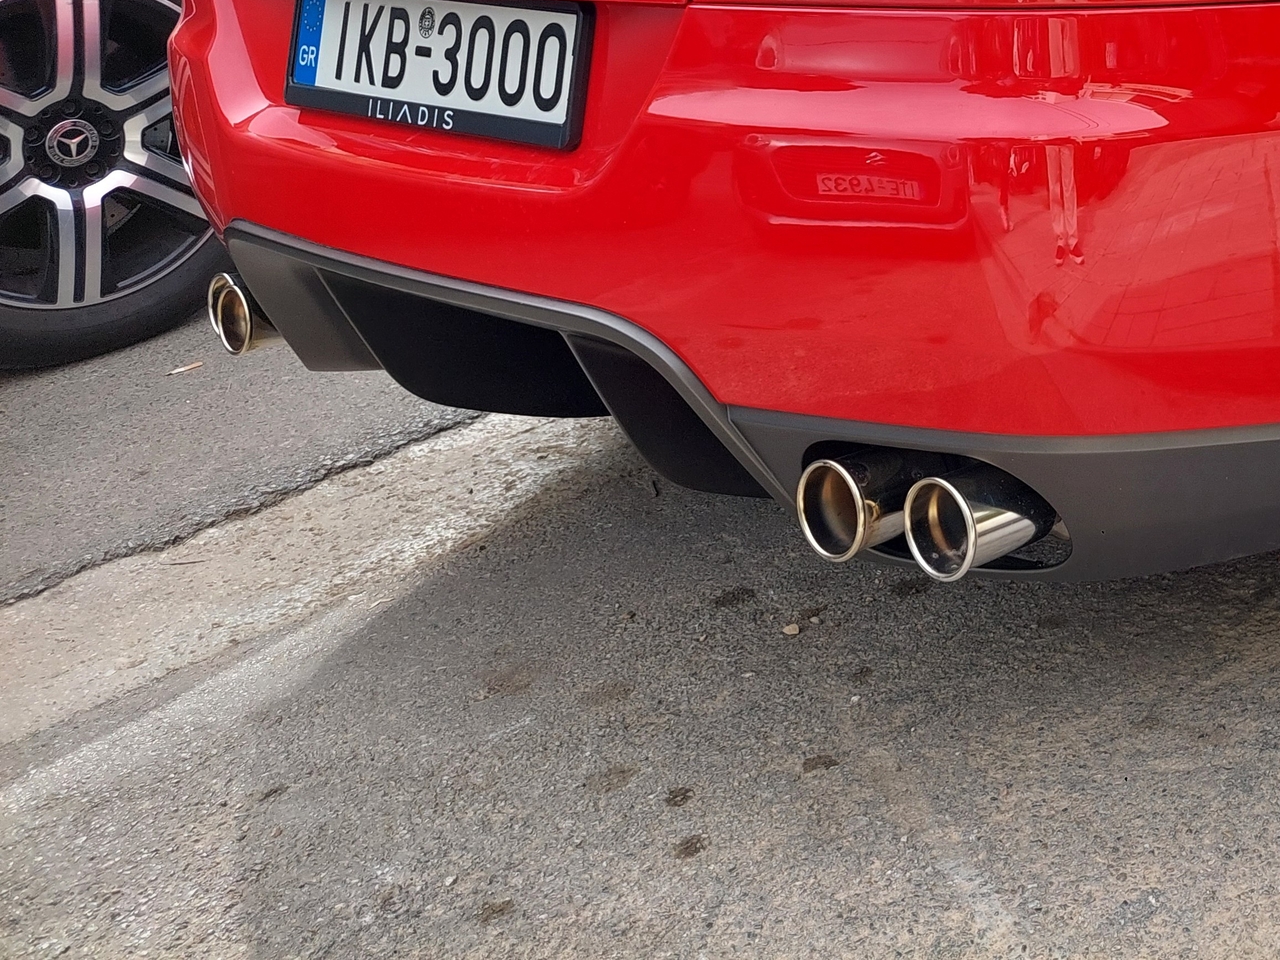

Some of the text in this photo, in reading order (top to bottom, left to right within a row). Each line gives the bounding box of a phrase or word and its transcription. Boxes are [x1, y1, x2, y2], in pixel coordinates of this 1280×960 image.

[299, 44, 316, 68] GR
[335, 0, 568, 113] IKB-3000
[367, 98, 455, 130] ILIADIS
